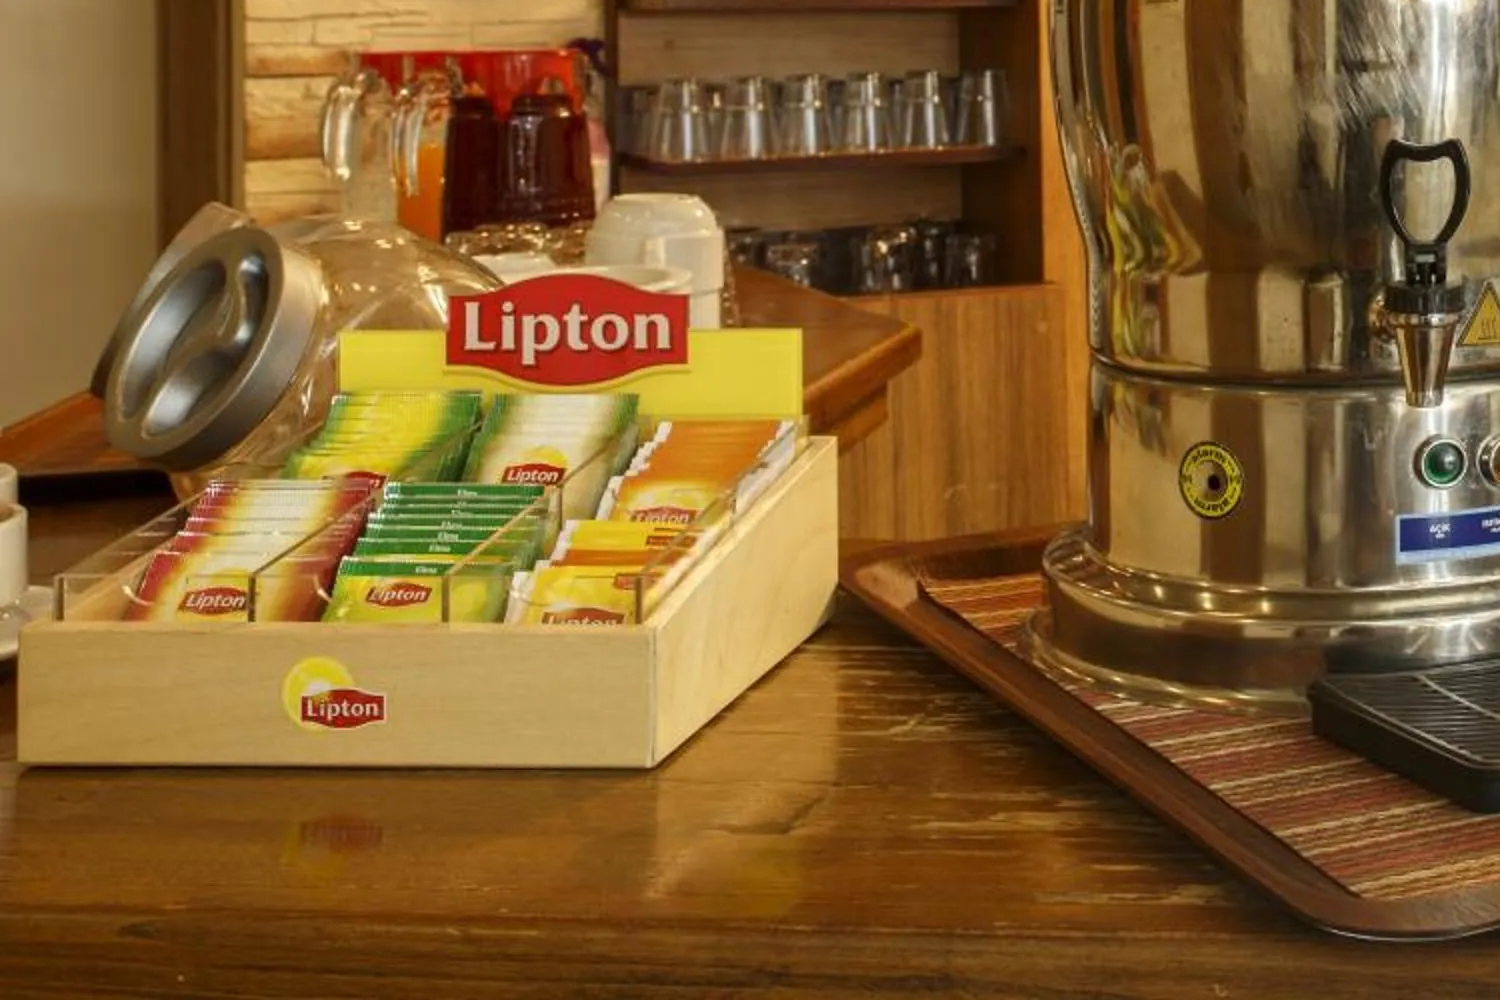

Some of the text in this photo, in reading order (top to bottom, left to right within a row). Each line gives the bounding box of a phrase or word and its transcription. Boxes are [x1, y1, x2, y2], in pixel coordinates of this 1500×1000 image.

[463, 300, 674, 367] Lipton
[506, 467, 560, 484] Lipton
[185, 588, 247, 612] Lipton
[370, 584, 428, 603] Lipton
[307, 697, 379, 721] Lipton
